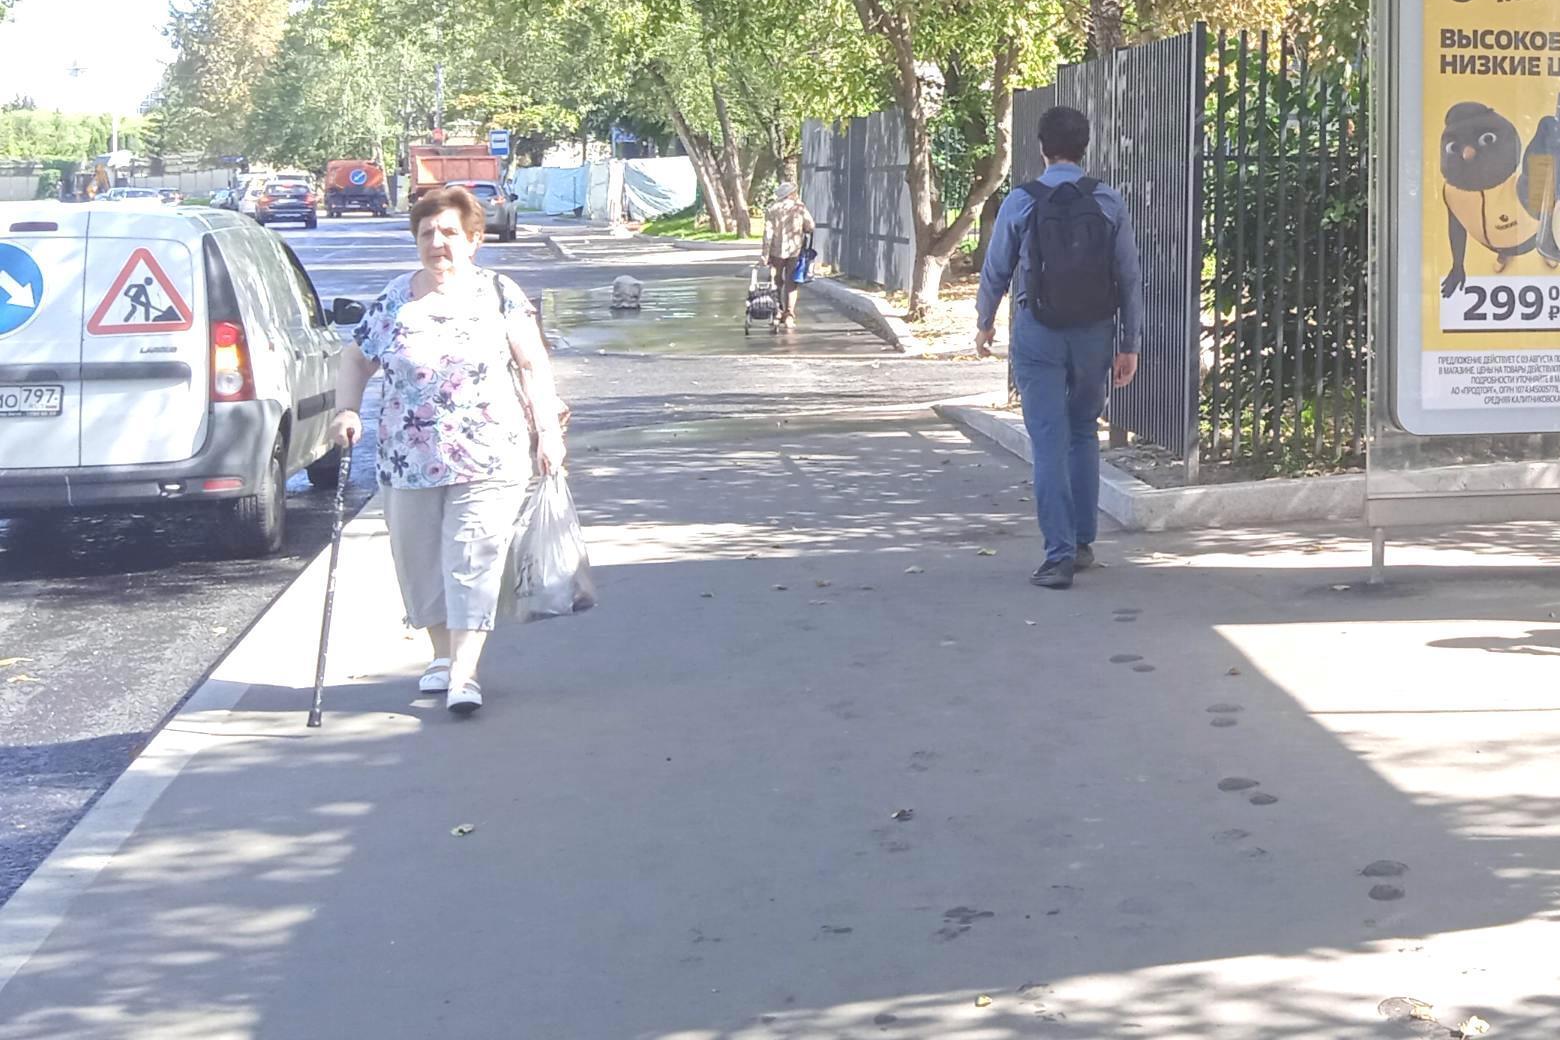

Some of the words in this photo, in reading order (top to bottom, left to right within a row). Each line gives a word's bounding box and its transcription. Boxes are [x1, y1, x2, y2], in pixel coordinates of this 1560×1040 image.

[1440, 54, 1542, 77] НИЗКИЕ
[1463, 285, 1544, 321] 299
[22, 388, 57, 403] 797
